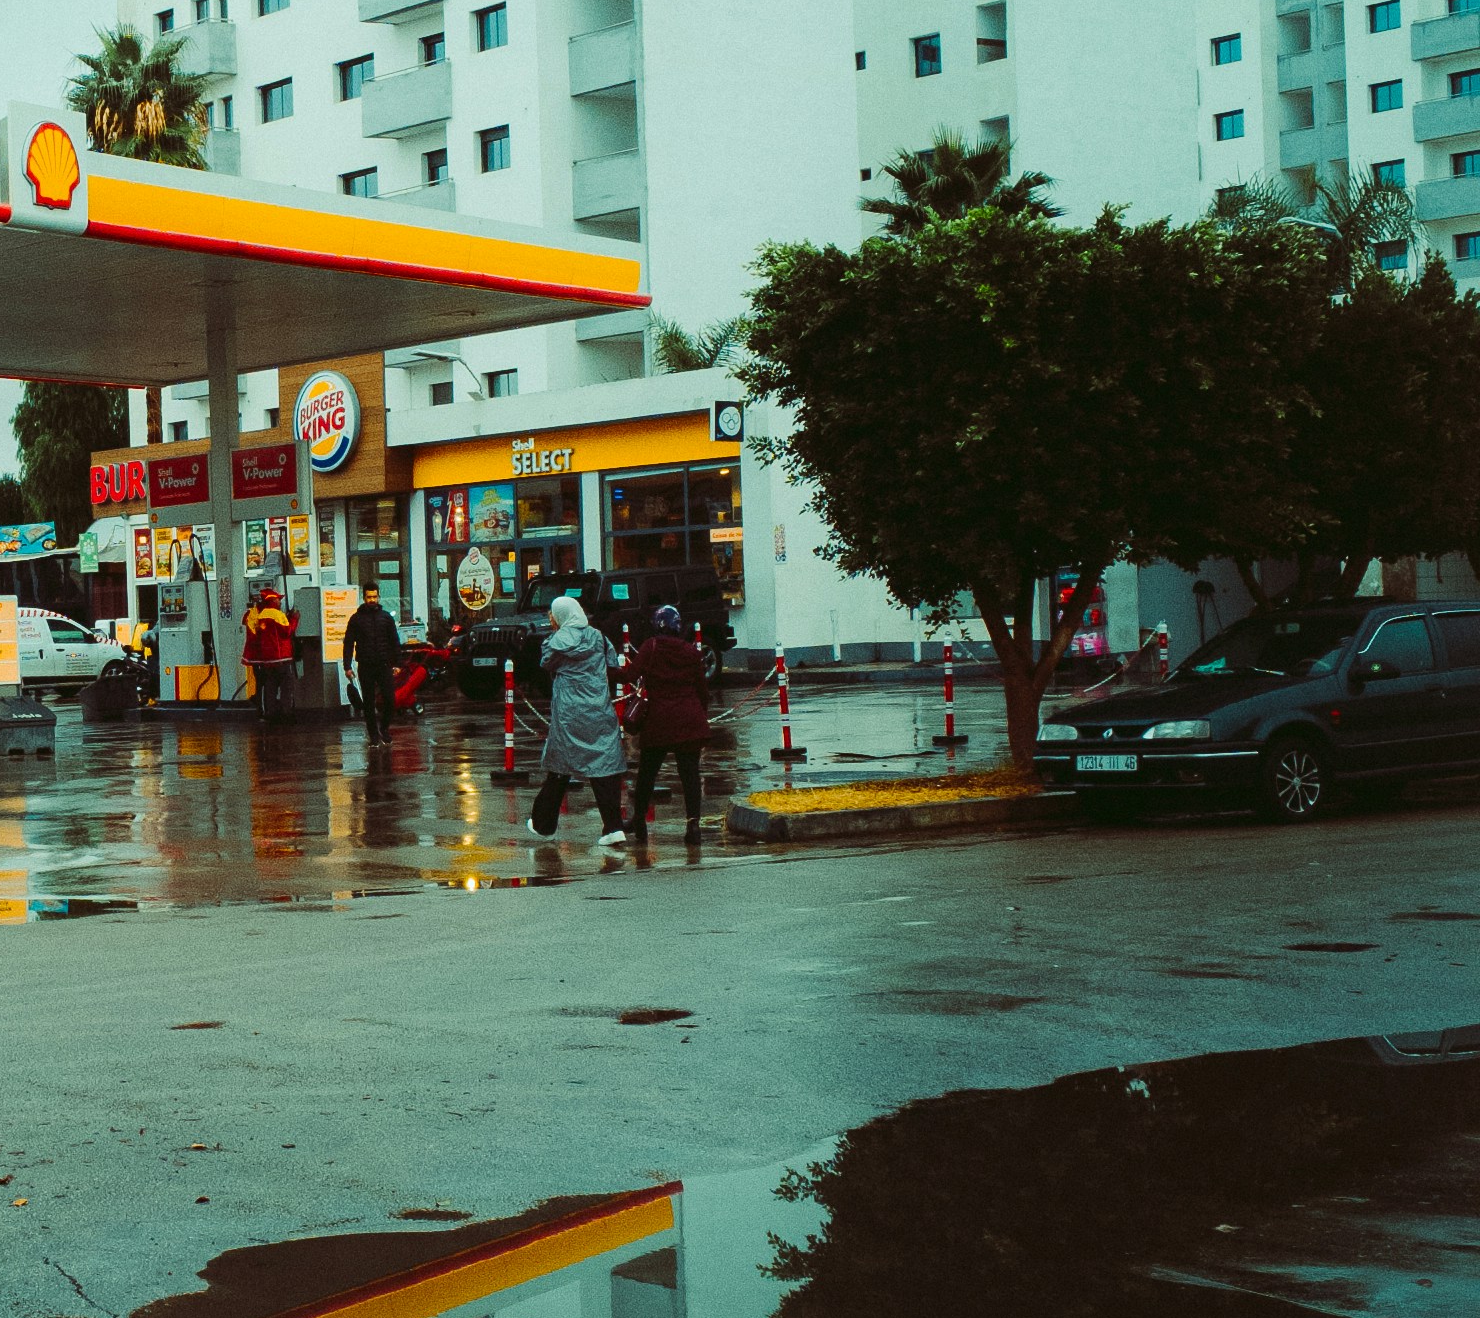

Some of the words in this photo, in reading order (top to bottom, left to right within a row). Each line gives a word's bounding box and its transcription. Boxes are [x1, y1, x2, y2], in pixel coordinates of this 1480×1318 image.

[300, 390, 344, 425] BURGER
[302, 407, 345, 441] KING
[512, 438, 534, 451] Shell
[242, 457, 257, 467] Shell
[512, 448, 573, 475] SELECT
[158, 467, 173, 477] Shell
[243, 467, 283, 480] V-Power
[90, 460, 146, 505] BUR
[159, 477, 196, 489] V-Power
